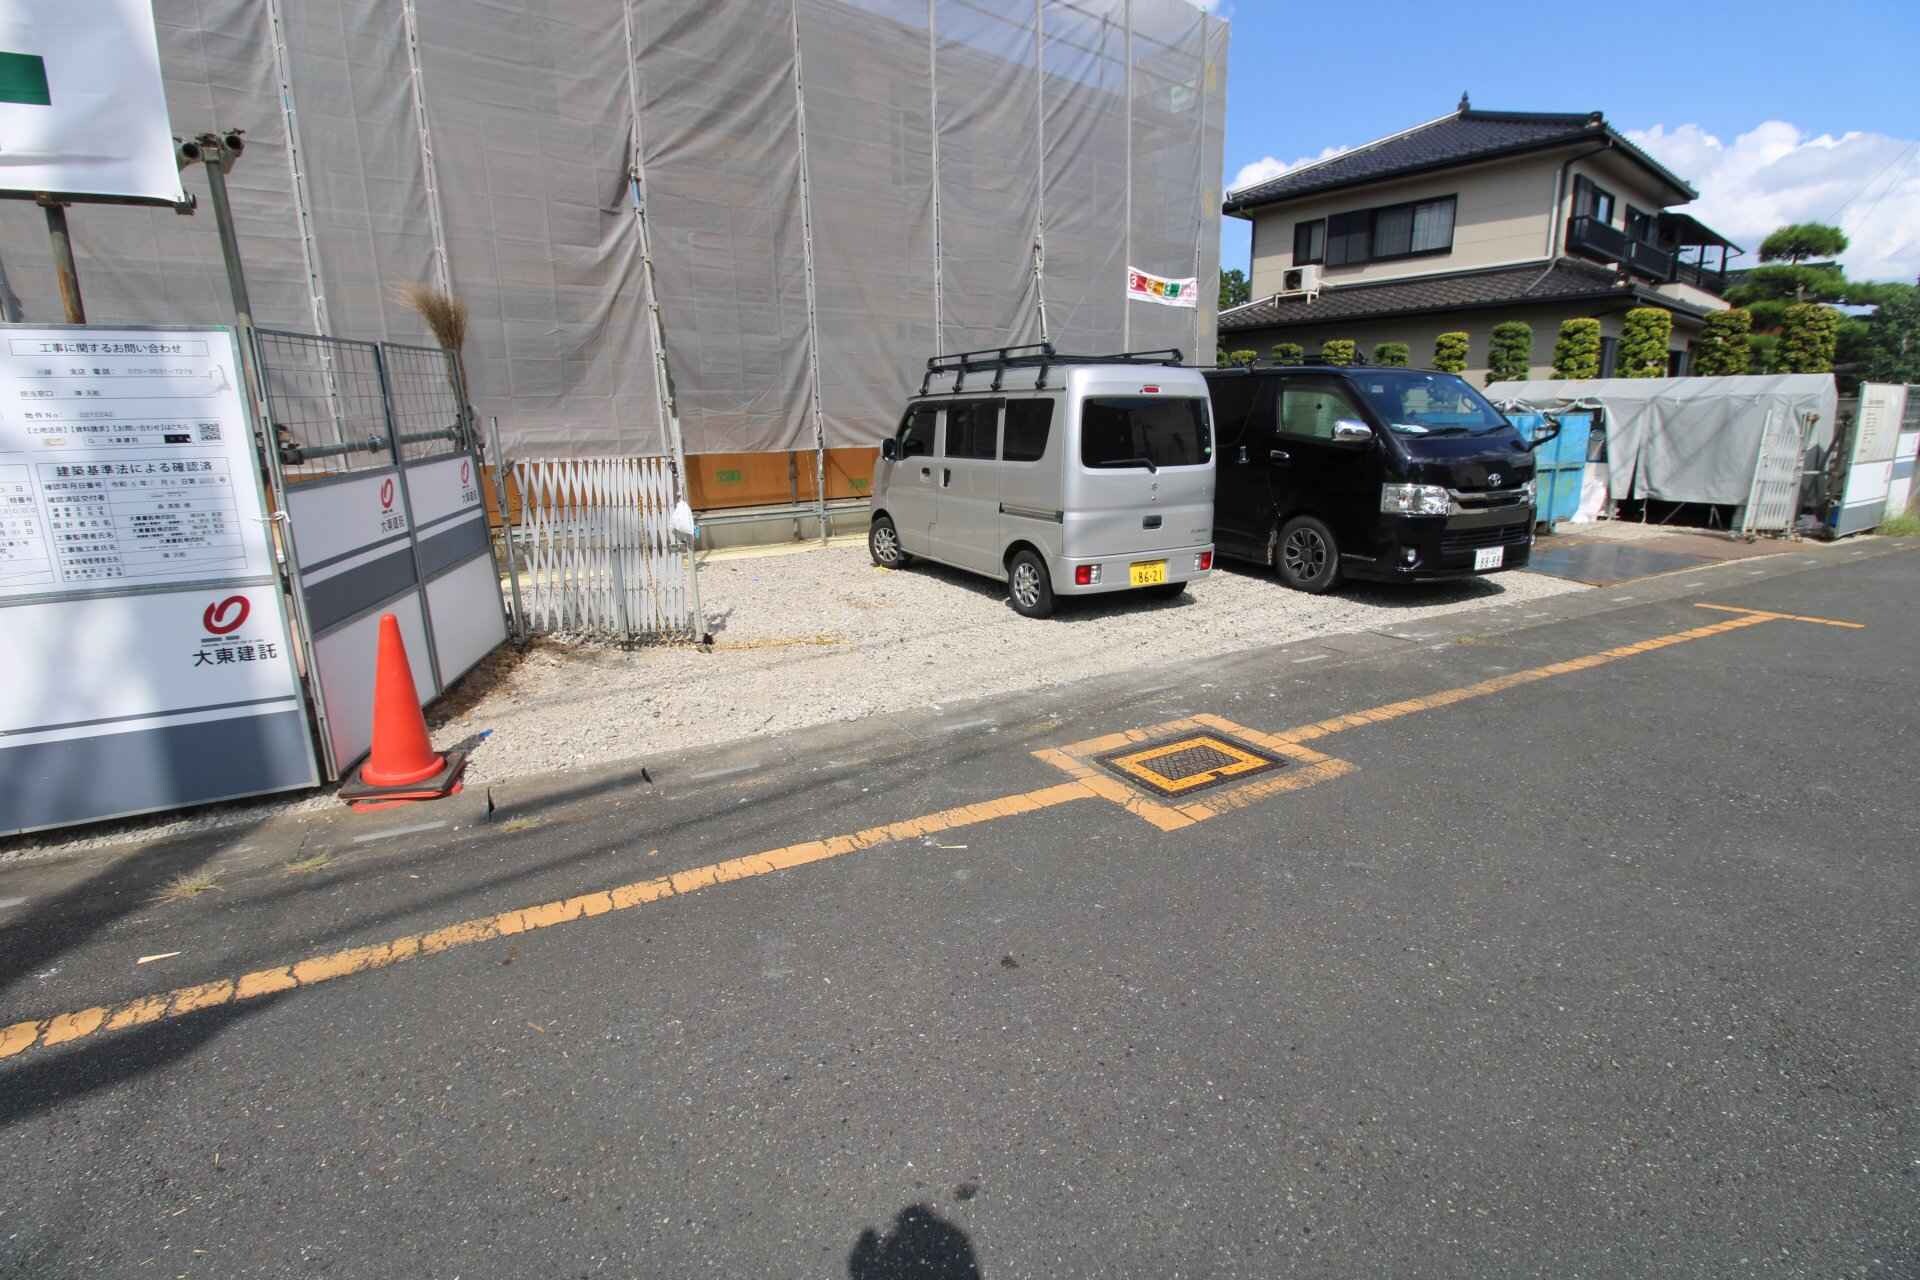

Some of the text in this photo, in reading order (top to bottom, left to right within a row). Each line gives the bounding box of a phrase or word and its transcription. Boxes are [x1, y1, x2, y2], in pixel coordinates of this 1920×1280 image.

[40, 343, 182, 354] 工事に関するお問い合わせ
[56, 461, 213, 477] 建築基準法による確認済
[192, 643, 278, 667] 大東建託
